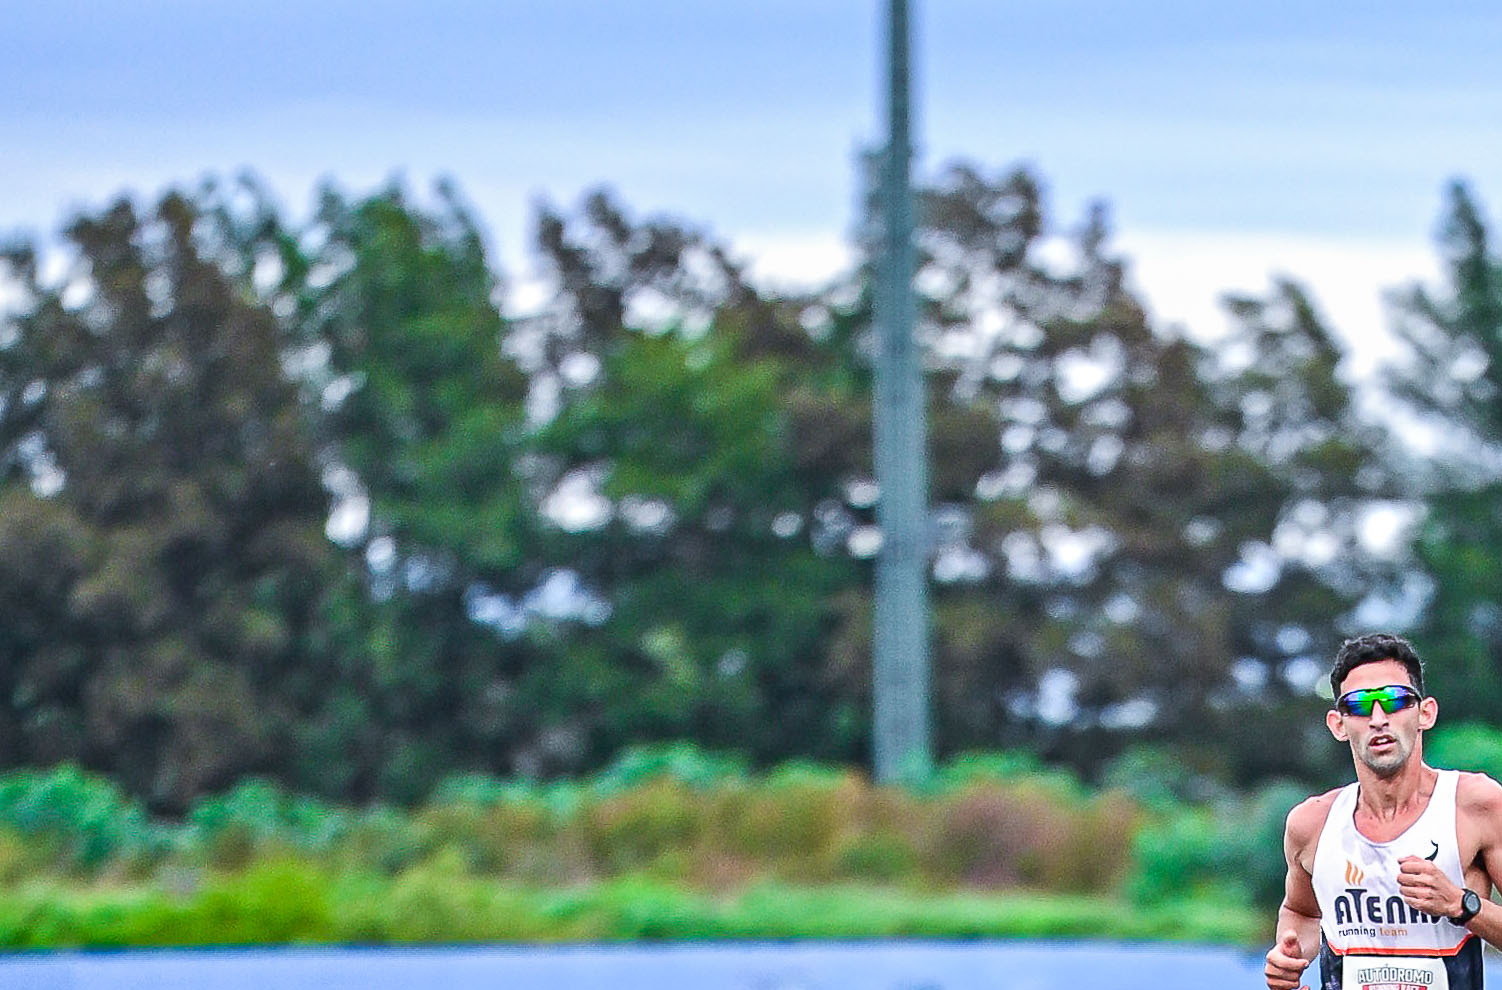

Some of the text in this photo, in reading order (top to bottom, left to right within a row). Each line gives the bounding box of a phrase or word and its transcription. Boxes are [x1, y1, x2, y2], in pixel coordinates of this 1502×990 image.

[1334, 888, 1441, 925] ATEN
[1338, 926, 1408, 937] running team
